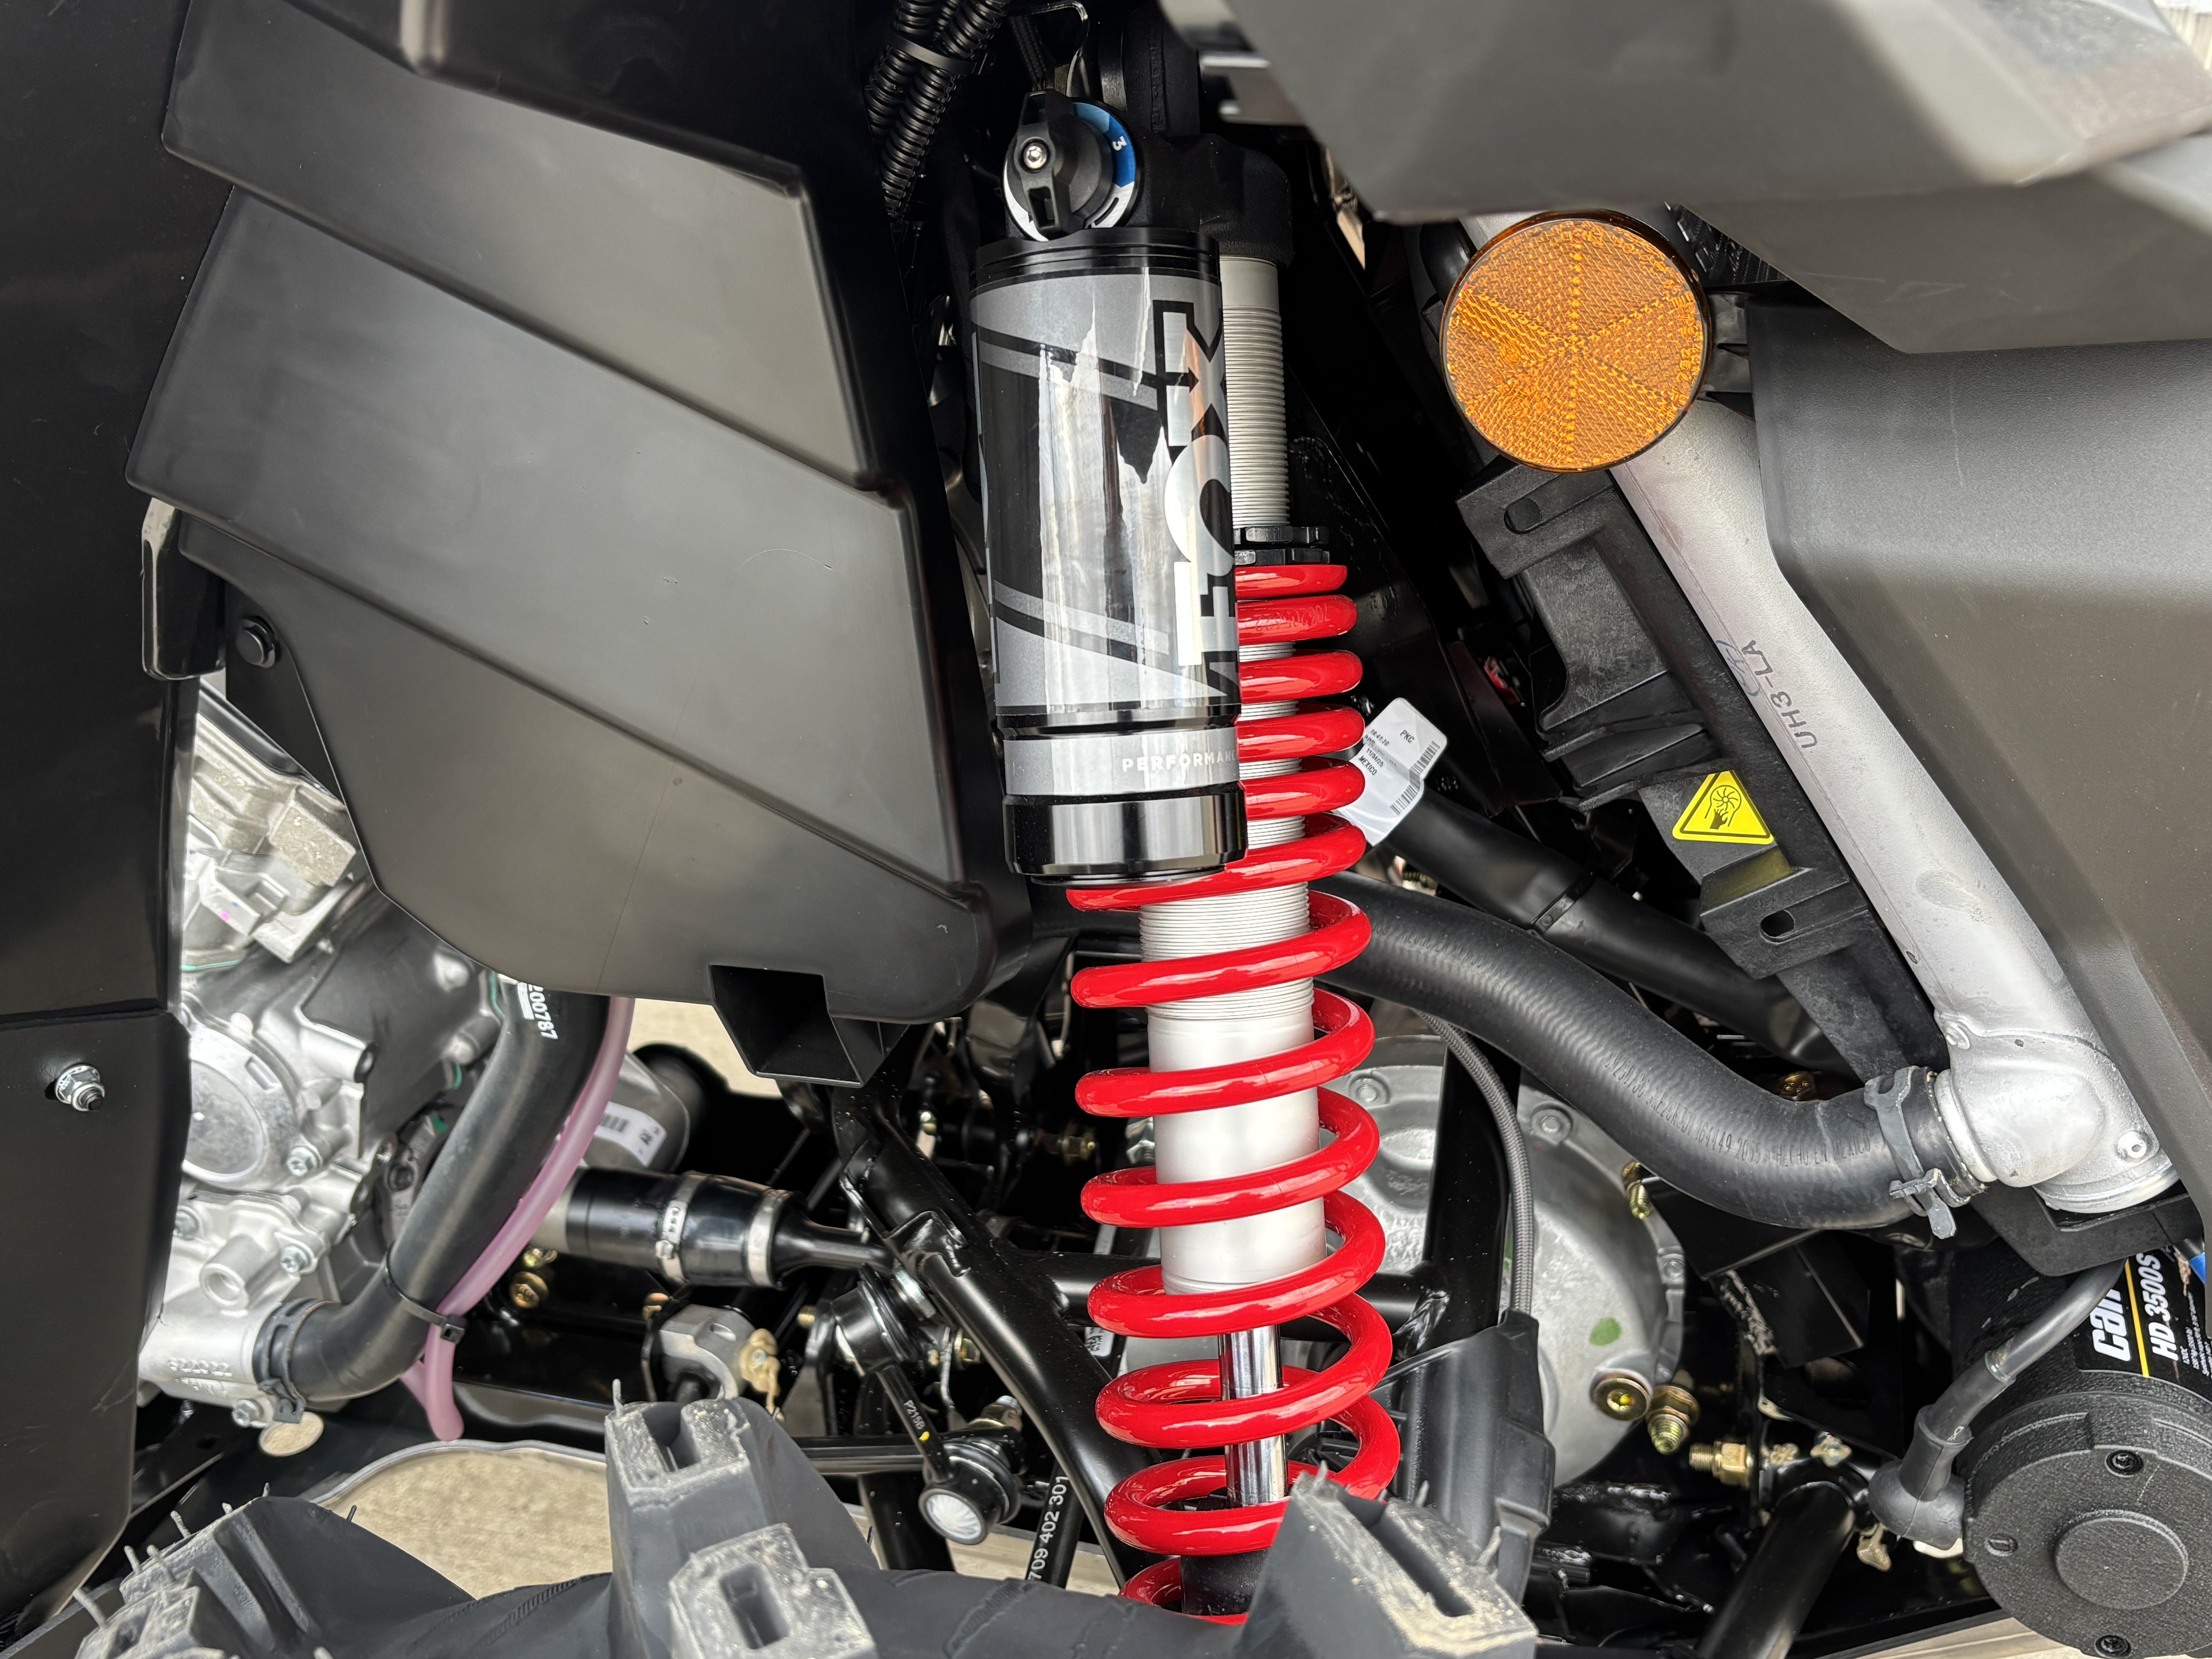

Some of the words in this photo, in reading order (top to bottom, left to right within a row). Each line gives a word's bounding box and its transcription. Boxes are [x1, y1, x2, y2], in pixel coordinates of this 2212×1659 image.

[1112, 136, 1127, 151] 3
[1741, 640, 1818, 749] UH3-LA
[1400, 729, 1415, 744] PKC
[1358, 756, 1377, 776] MEXICO
[2148, 1322, 2178, 1361] HD
[1049, 1476, 1069, 1506] 301
[1039, 1511, 1060, 1544] 402
[1028, 1548, 1049, 1580] 709
